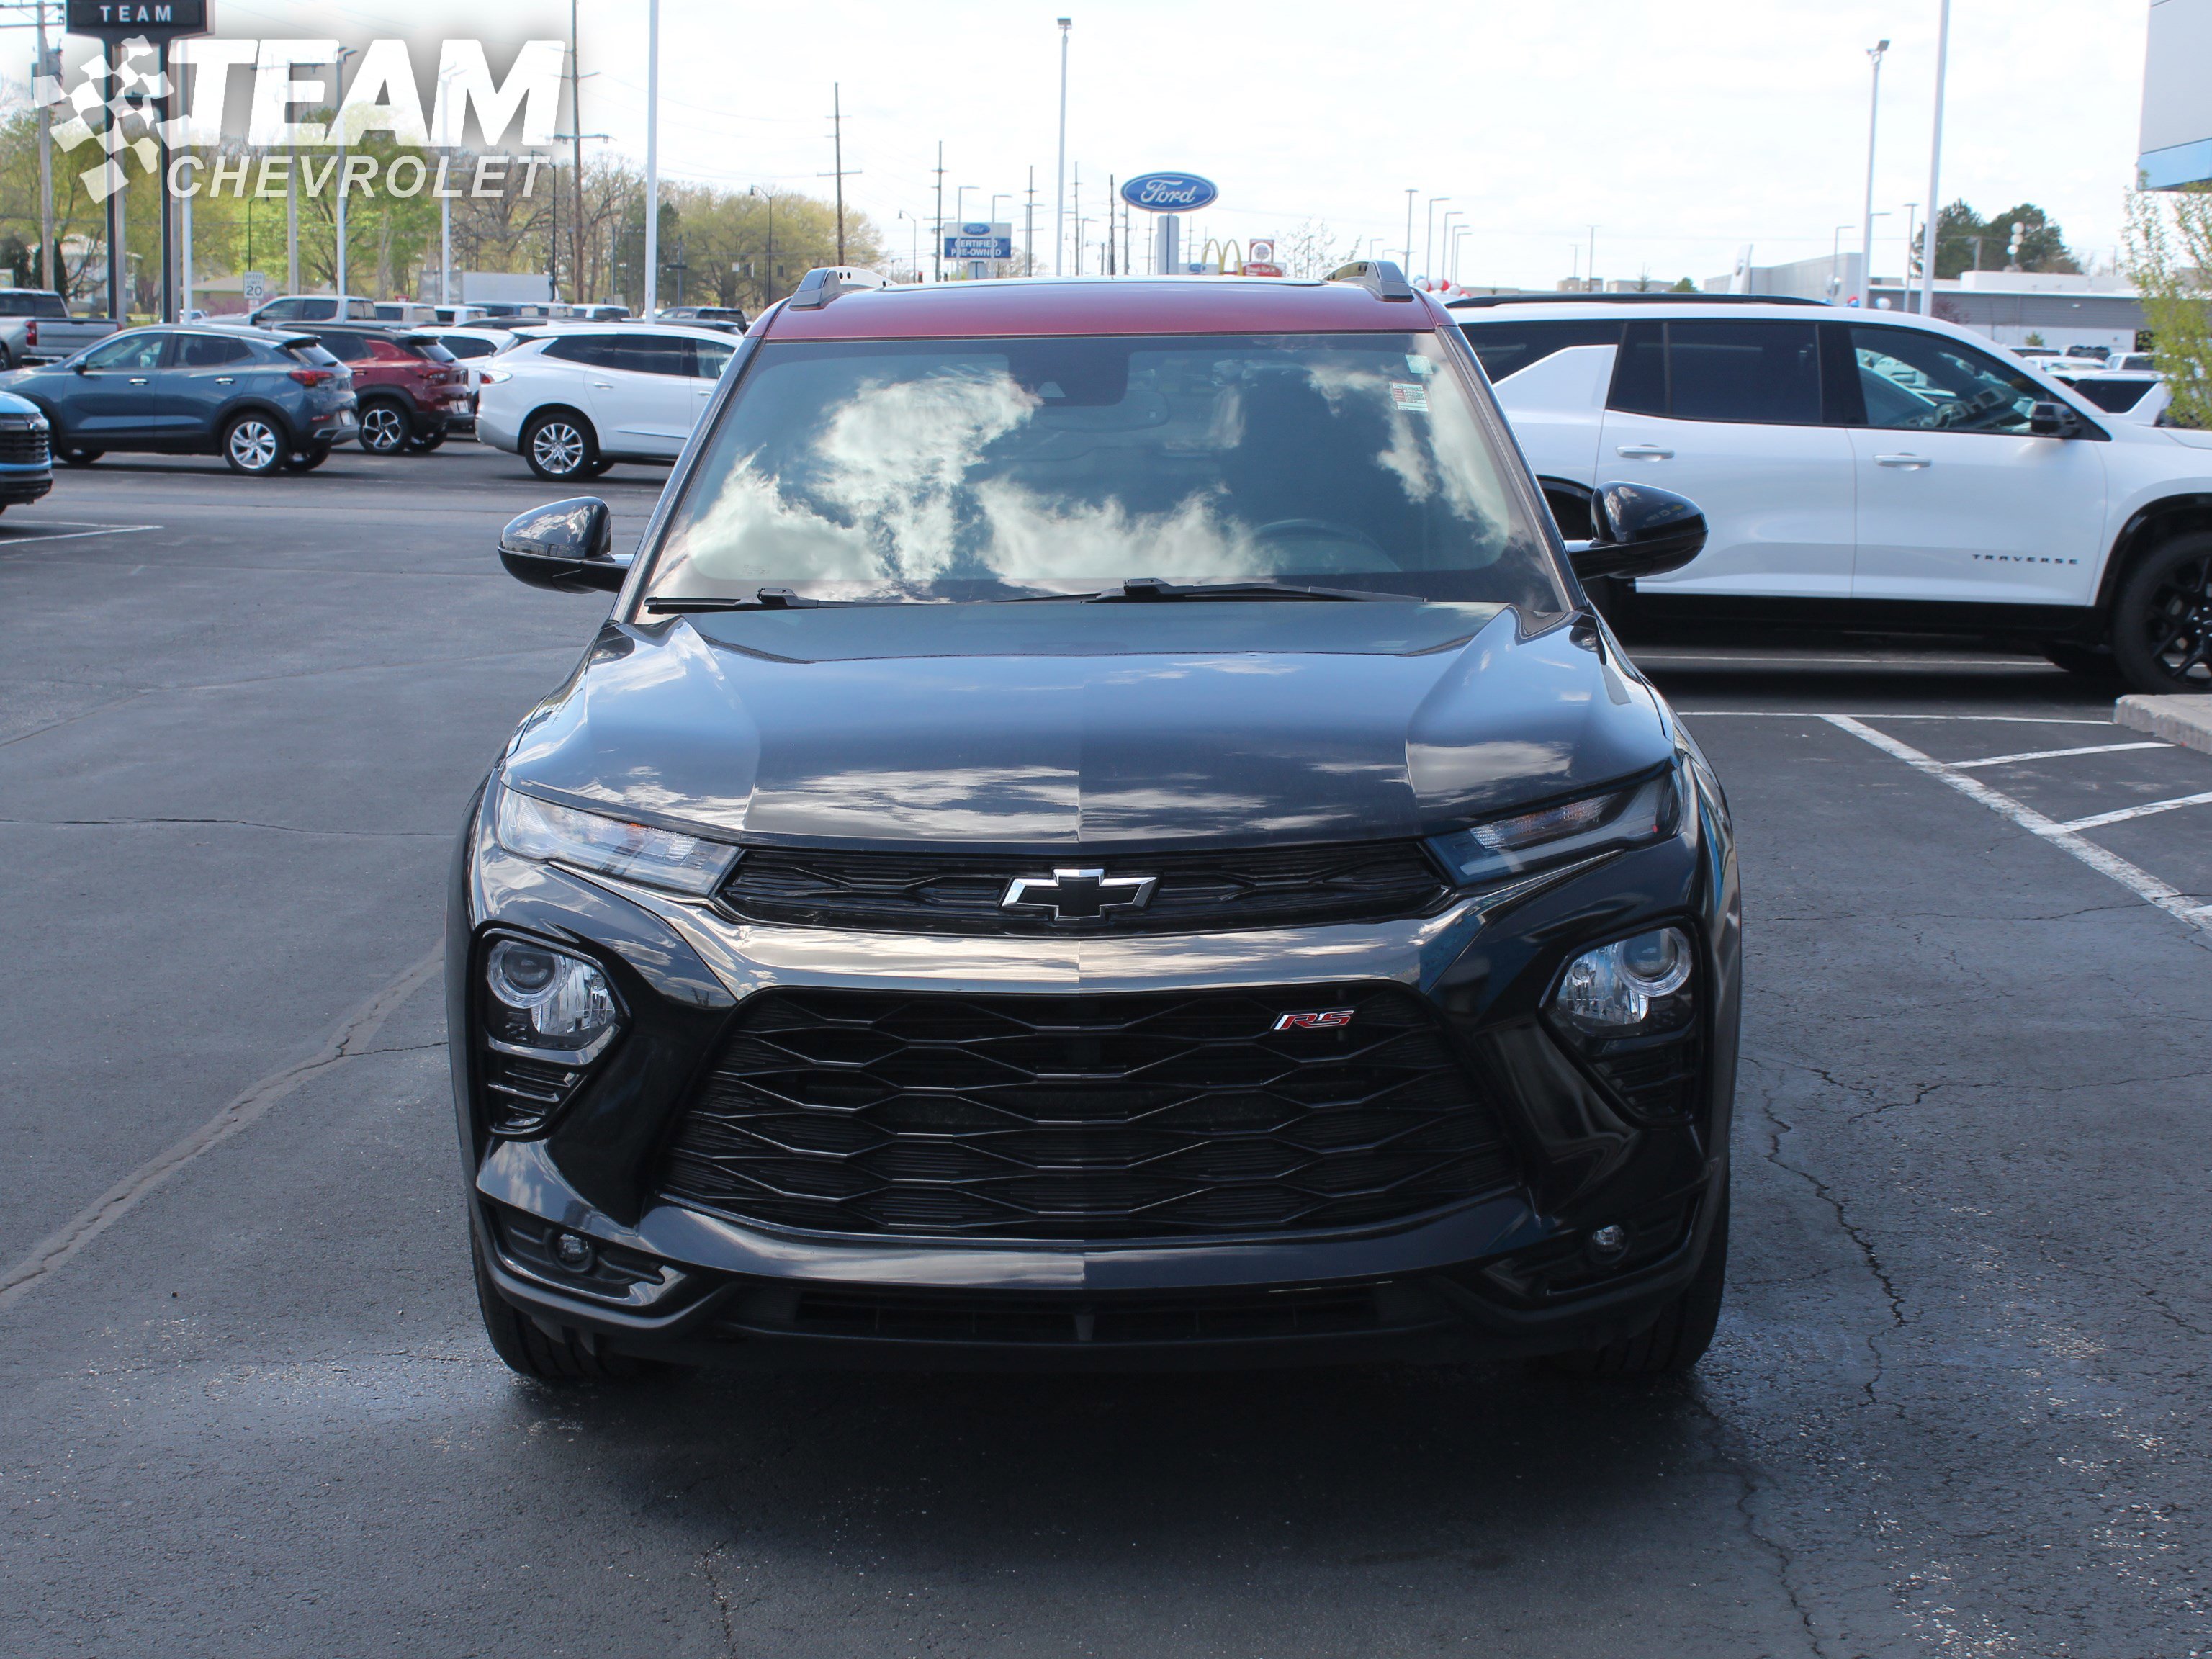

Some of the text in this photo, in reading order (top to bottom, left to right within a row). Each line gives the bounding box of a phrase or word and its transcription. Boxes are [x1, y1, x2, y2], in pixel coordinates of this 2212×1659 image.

[99, 5, 172, 22] TEAM
[1140, 179, 1197, 204] Ford
[246, 286, 262, 296] 20
[1972, 554, 2079, 565] TRAVERSE
[1274, 1010, 1354, 1030] RS
